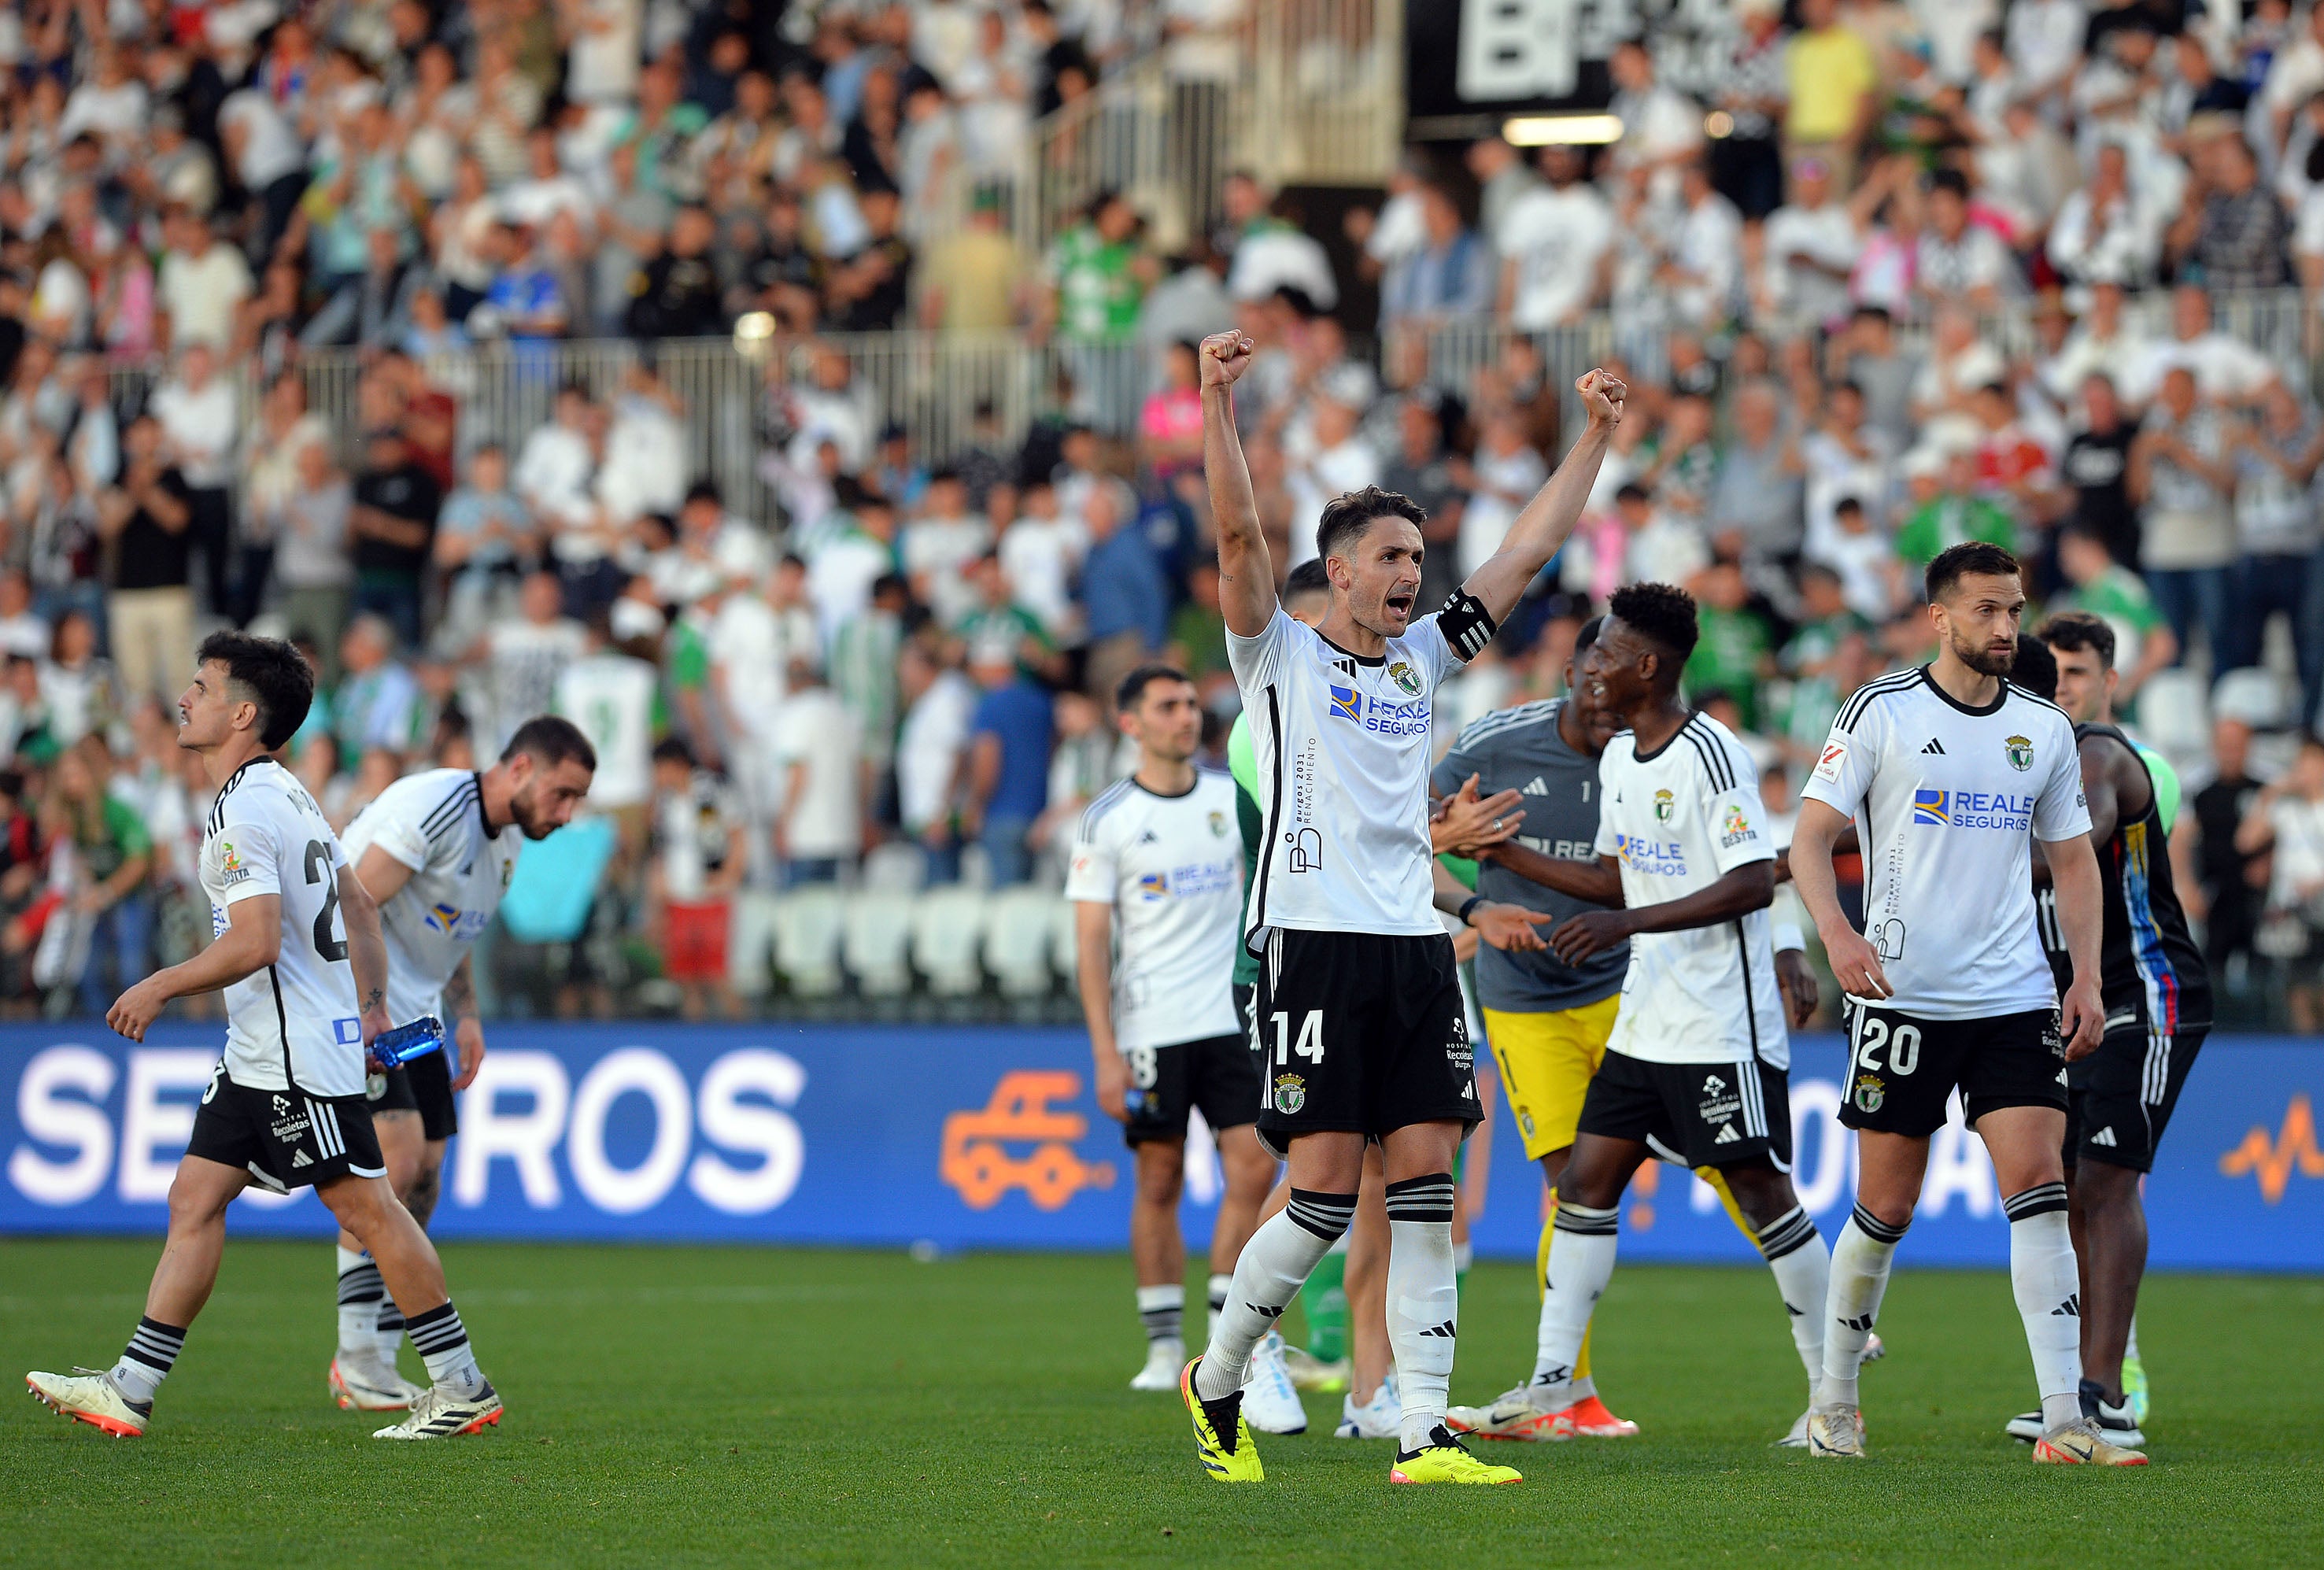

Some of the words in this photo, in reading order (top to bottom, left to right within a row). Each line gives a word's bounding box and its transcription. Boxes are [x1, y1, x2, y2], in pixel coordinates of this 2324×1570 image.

[1296, 753, 1305, 779] 2031
[1304, 737, 1317, 824] RENACIMIENTO
[1956, 792, 2034, 815] REALE
[1269, 1010, 1325, 1065] 14
[1858, 1018, 1922, 1076] 20
[1499, 1047, 1518, 1094] 1
[6, 1044, 809, 1217] SEROS
